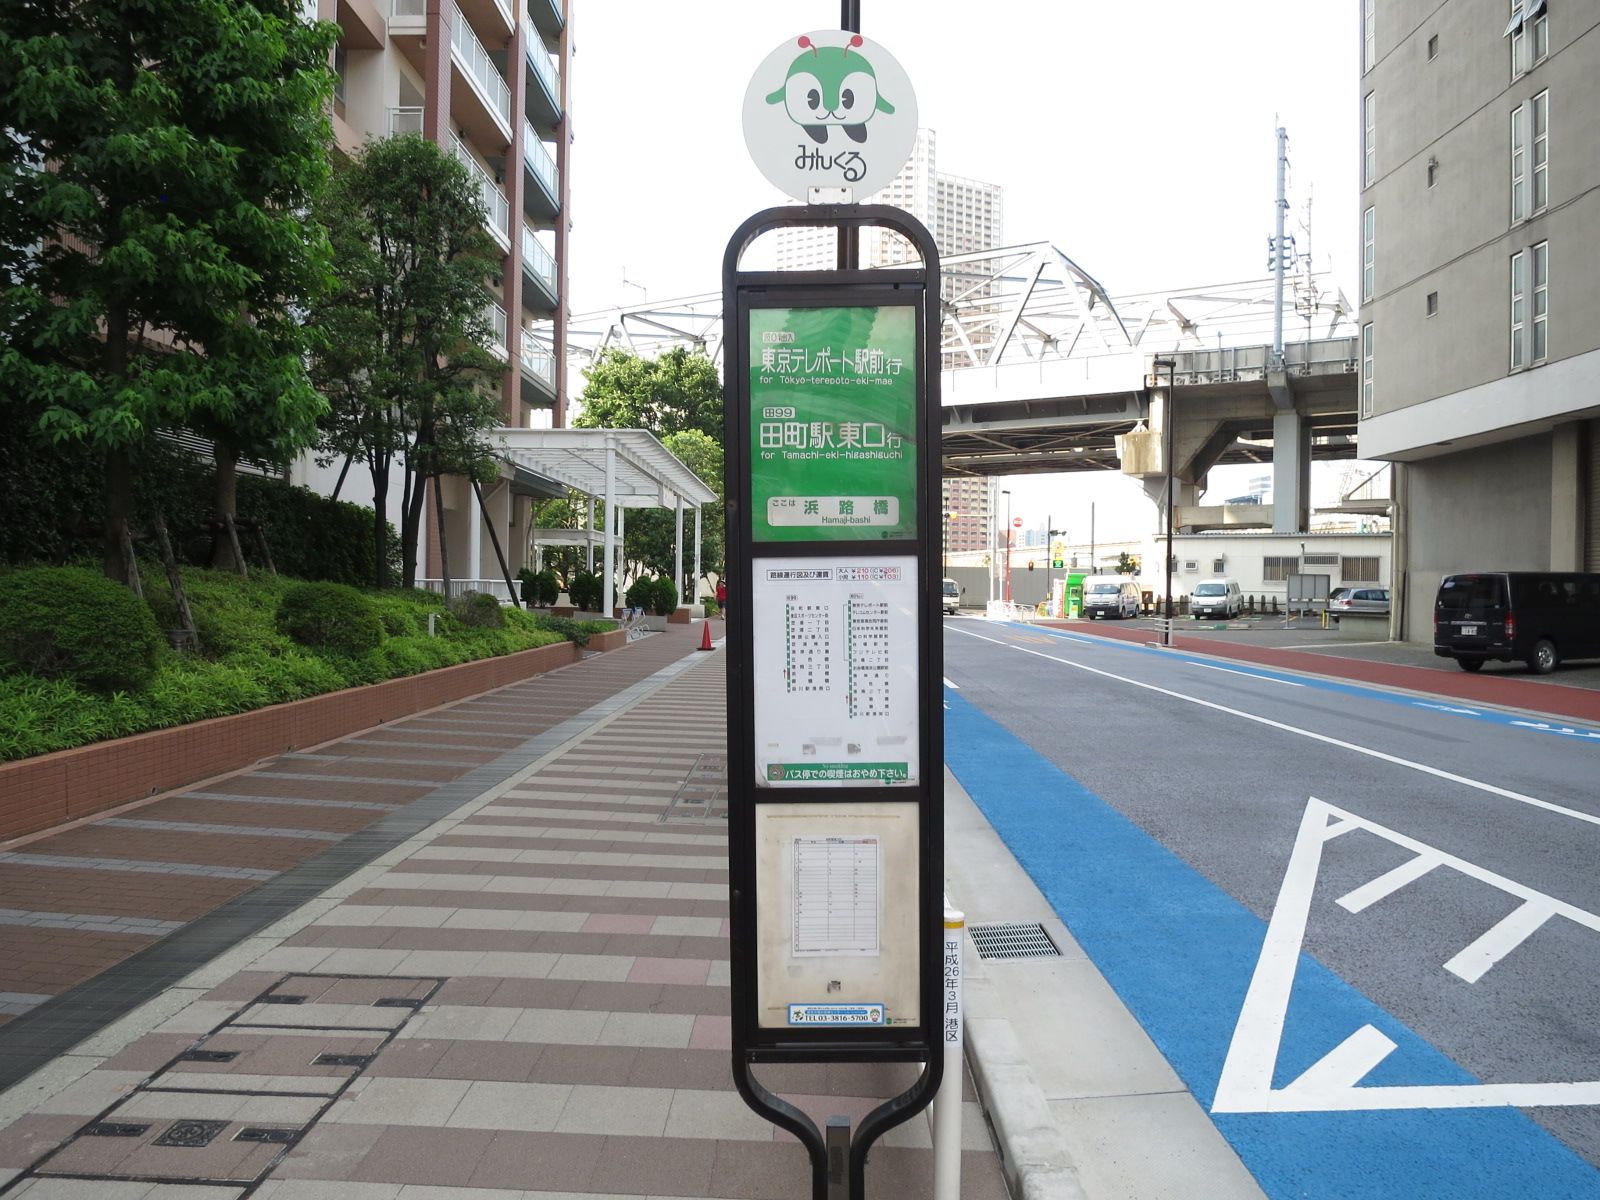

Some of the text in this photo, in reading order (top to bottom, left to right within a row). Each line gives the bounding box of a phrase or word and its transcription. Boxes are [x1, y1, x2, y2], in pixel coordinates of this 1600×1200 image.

[795, 144, 867, 182] みんくる
[761, 347, 903, 375] 東京テレポート駅前行
[759, 375, 773, 384] for
[765, 408, 793, 417] 田99
[760, 422, 903, 449] 田町駅東口行
[760, 450, 903, 460] for Tamachi-eki-higashiguchi
[772, 499, 889, 515] ここは 浜路橋
[822, 516, 871, 525] Hamaji-bashi
[785, 768, 907, 779] バス停での喫煙はおやめ下さい。
[944, 941, 960, 1042] 平成26年3月 港区
